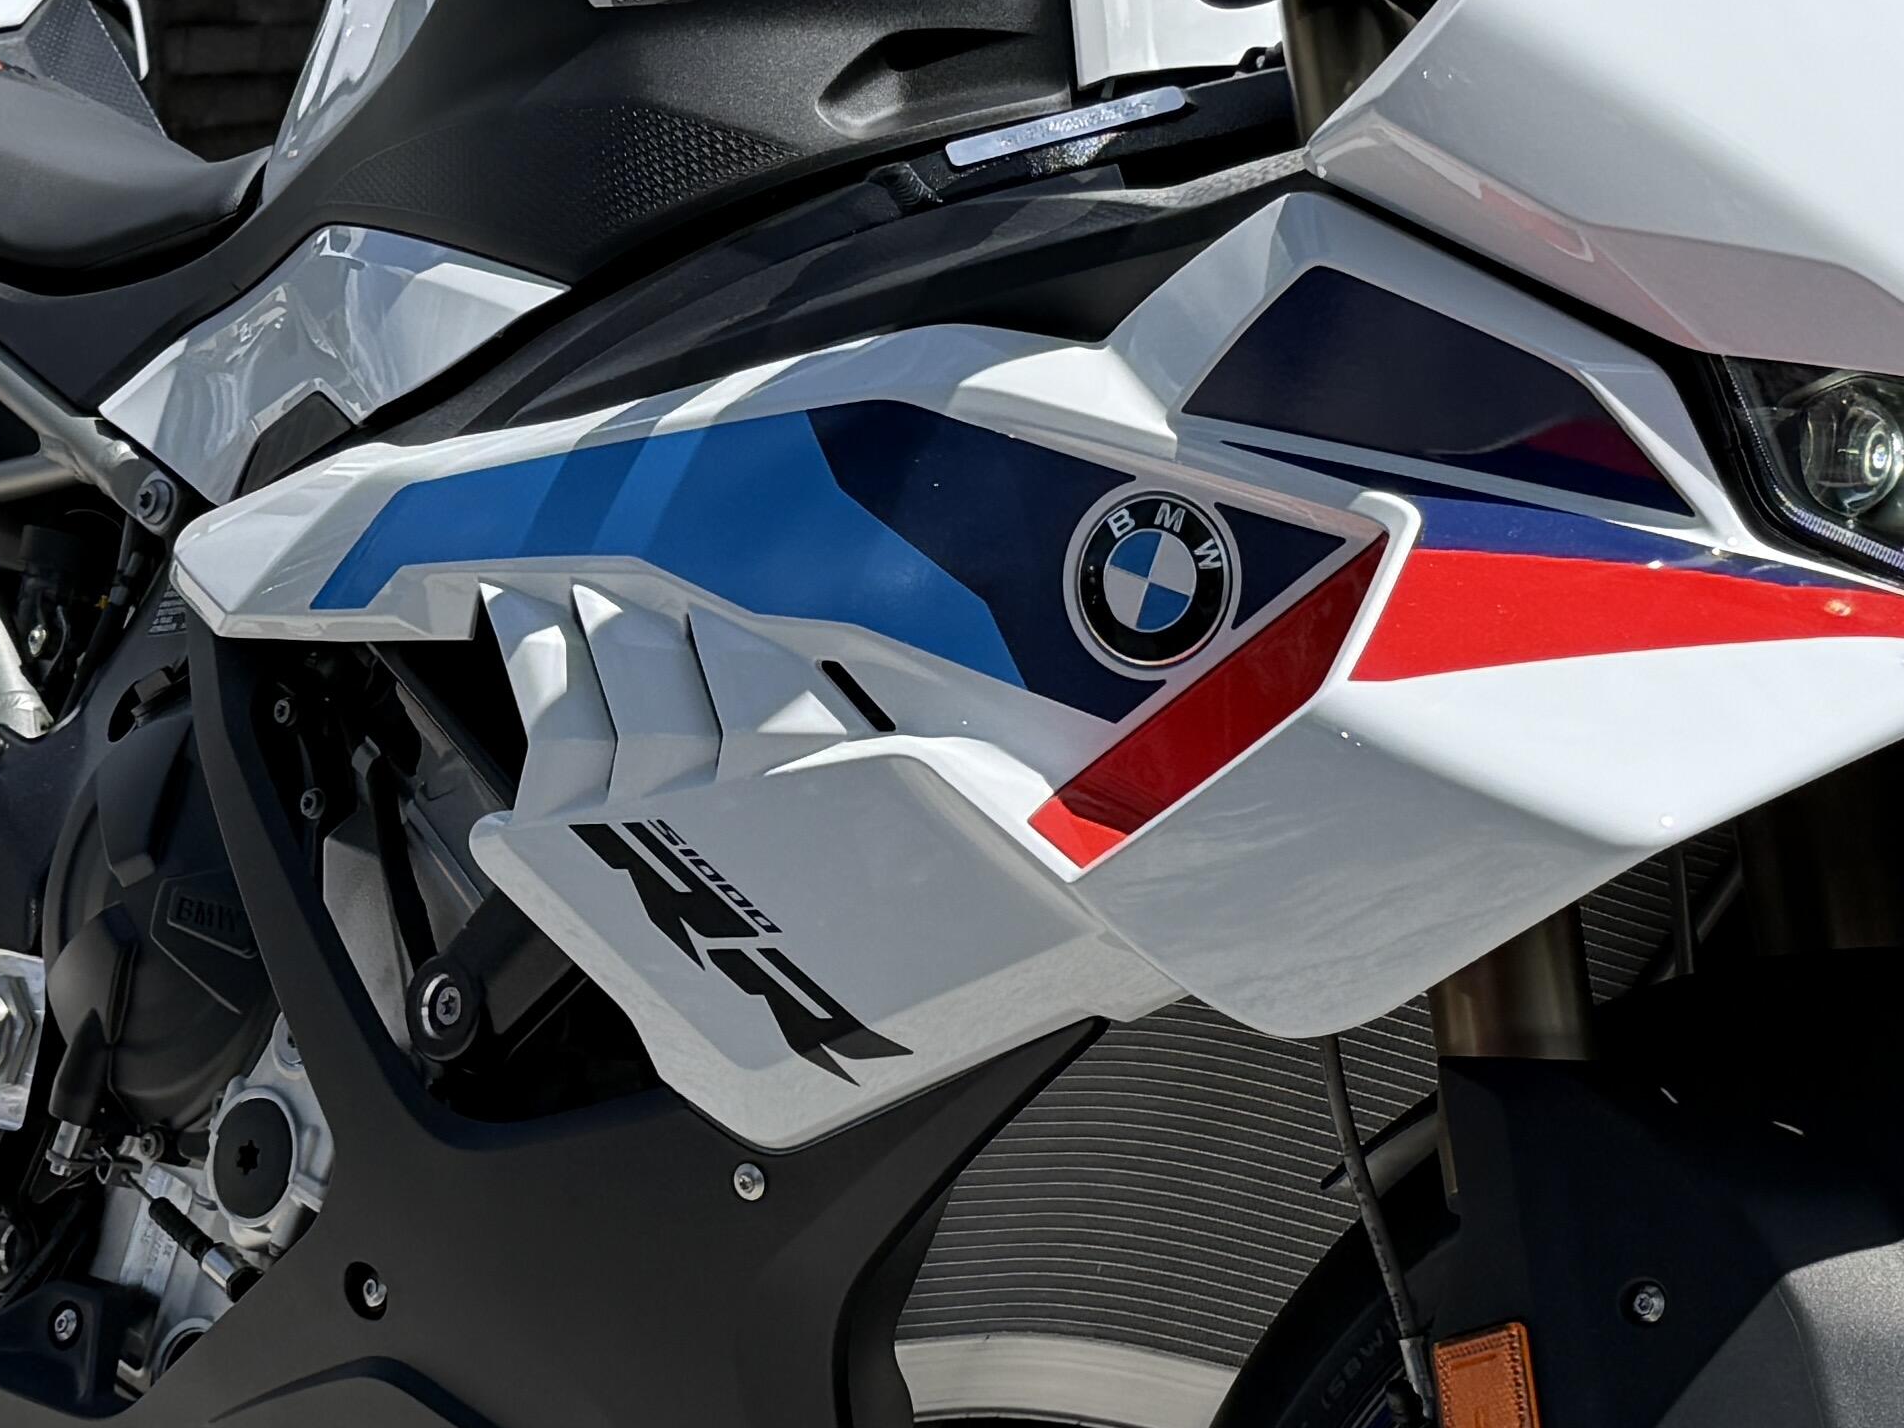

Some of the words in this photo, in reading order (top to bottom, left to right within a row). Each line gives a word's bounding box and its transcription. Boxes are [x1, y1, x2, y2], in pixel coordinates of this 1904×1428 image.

[1106, 501, 1223, 570] BMW
[647, 818, 783, 935] S1000
[567, 821, 915, 1087] RR
